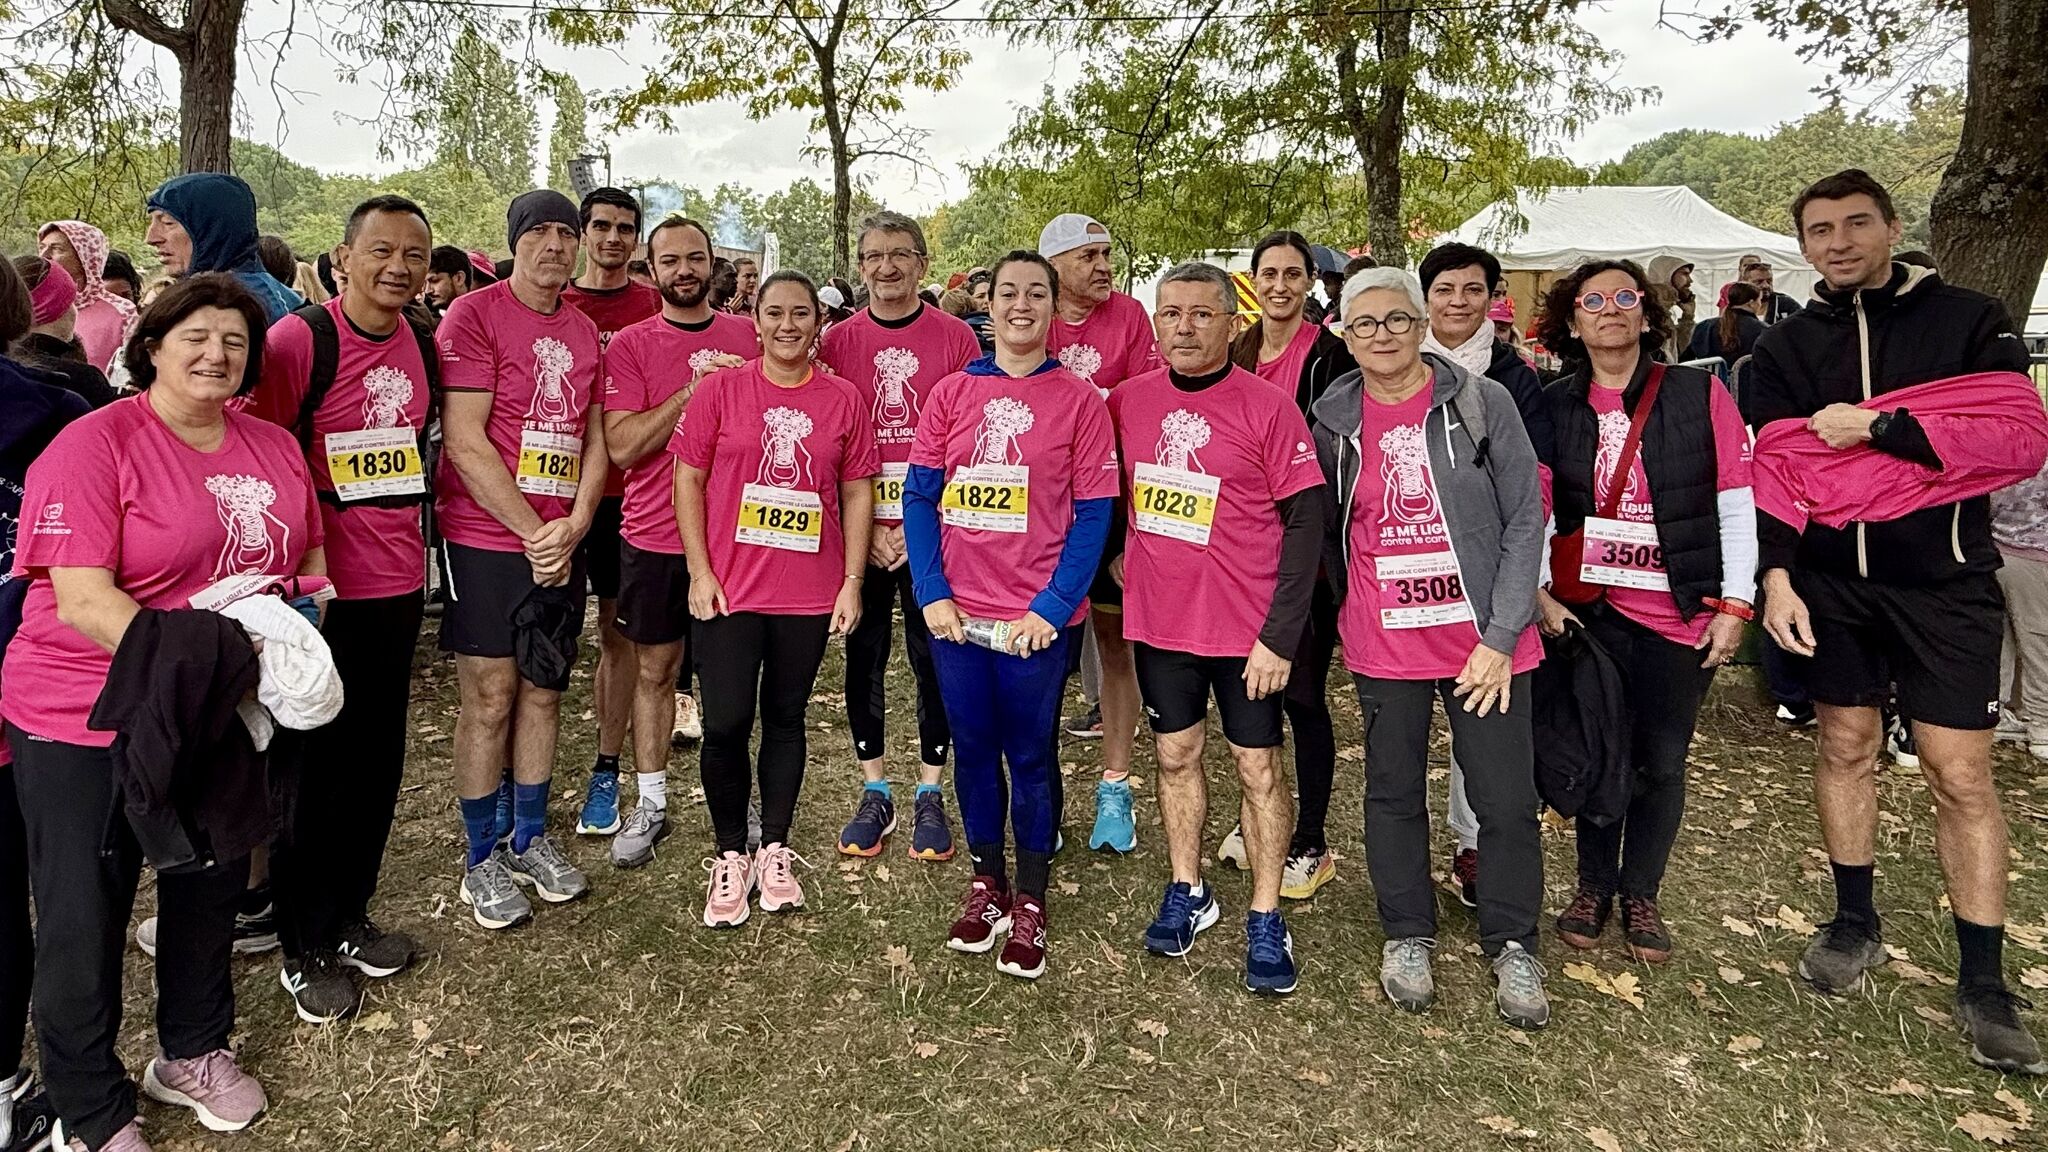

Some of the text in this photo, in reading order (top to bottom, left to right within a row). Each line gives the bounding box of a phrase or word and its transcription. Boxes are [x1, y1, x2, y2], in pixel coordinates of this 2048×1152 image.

[522, 420, 536, 430] JE
[538, 421, 555, 432] ME
[877, 427, 917, 437] ME LIGU
[364, 441, 386, 449] CONTRE
[347, 449, 406, 478] 1830
[536, 453, 574, 478] 1821
[876, 481, 905, 501] 18
[1161, 479, 1181, 488] CONTRE
[774, 499, 794, 507] CONTRE
[955, 484, 1012, 510] 1822
[1143, 486, 1198, 518] 1828
[756, 506, 809, 532] 1829
[1379, 523, 1446, 538] JE ME LIG
[1622, 533, 1647, 541] CONTRE
[1380, 537, 1412, 547] contre
[1413, 535, 1424, 545] le
[1601, 541, 1666, 569] 3509
[1412, 566, 1438, 574] CONTRE
[1395, 575, 1463, 605] 3508
[210, 600, 222, 609] ME
[222, 589, 243, 603] LIGUE
